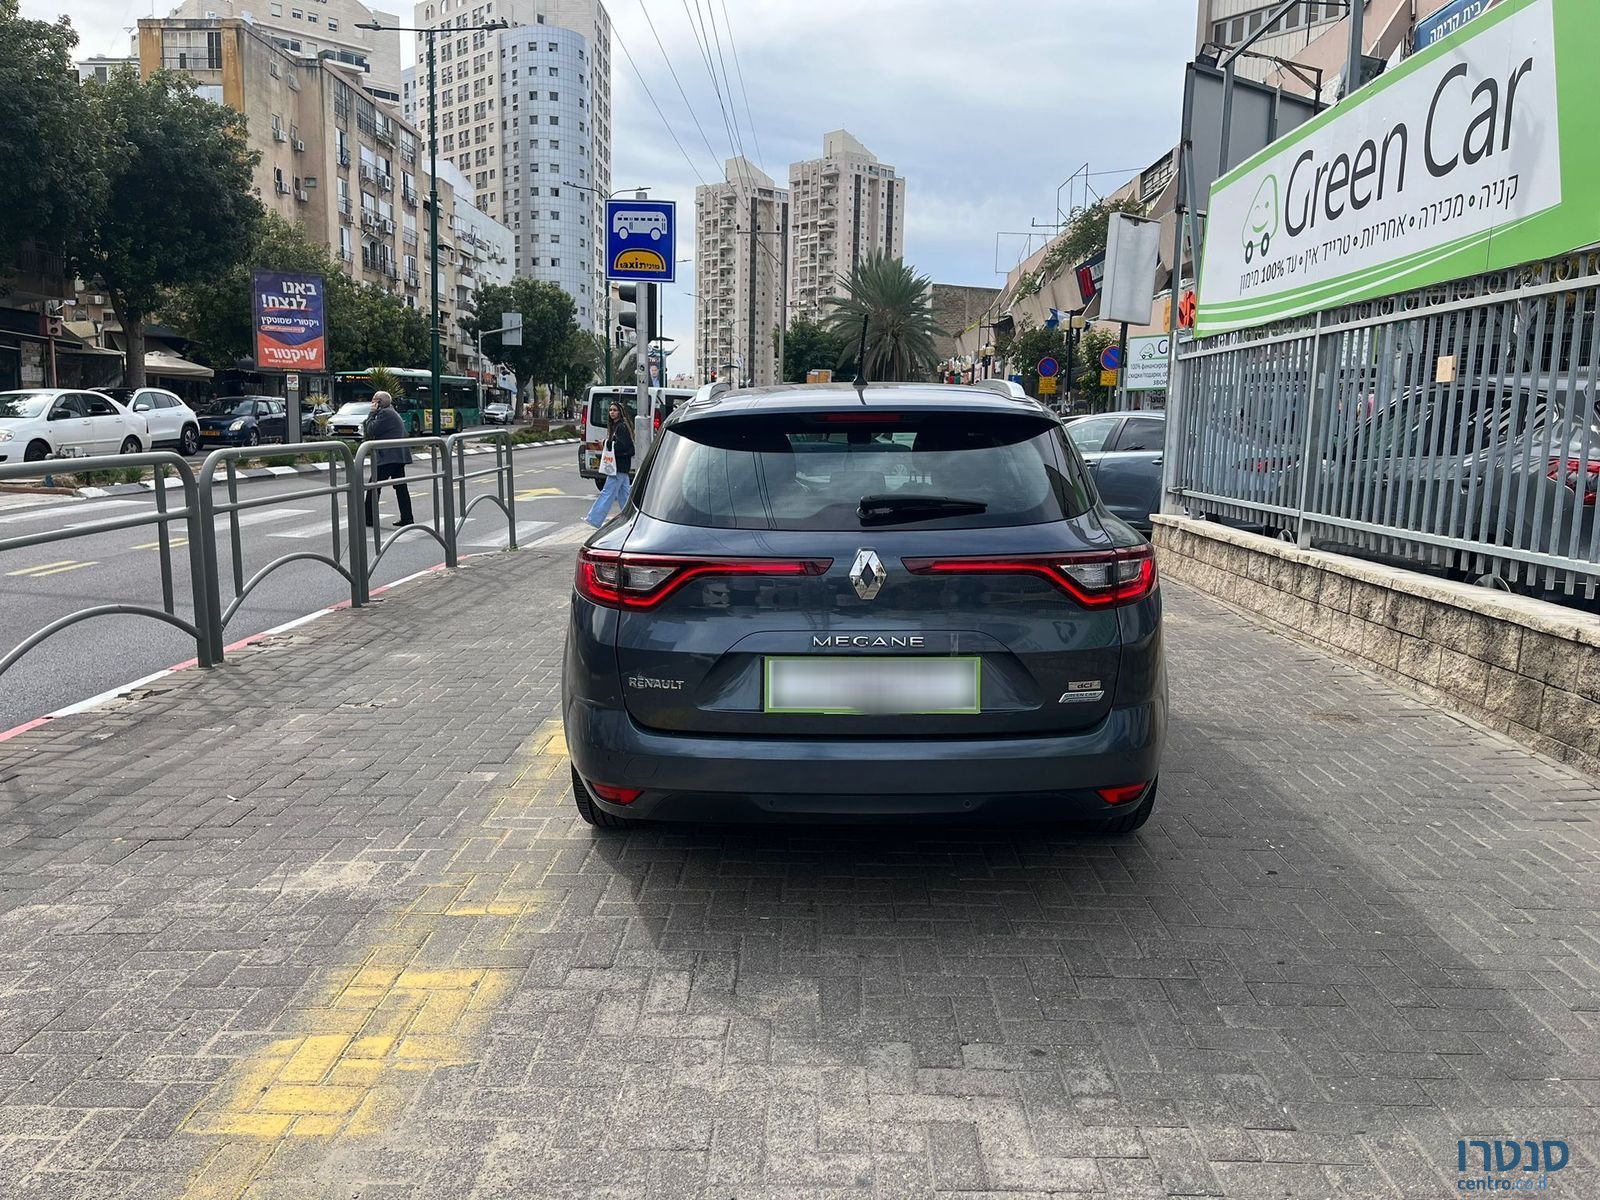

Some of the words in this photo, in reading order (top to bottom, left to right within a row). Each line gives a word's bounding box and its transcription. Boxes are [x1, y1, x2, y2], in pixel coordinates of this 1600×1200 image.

[1462, 1, 1481, 23] בית
[1284, 122, 1408, 237] Green
[1424, 56, 1533, 178] Car
[1478, 174, 1519, 210] קניה
[1418, 193, 1464, 230] מכירה
[1359, 213, 1407, 249] אחריות
[1304, 245, 1319, 274] אין
[1322, 234, 1351, 261] טרייד
[1261, 259, 1284, 283] 100%
[1286, 254, 1298, 274] עד
[282, 281, 317, 296] באנו
[1239, 269, 1259, 296] מימון
[261, 294, 307, 310] לנצח!
[812, 635, 925, 648] MEGANE
[628, 675, 684, 691] RENAULT
